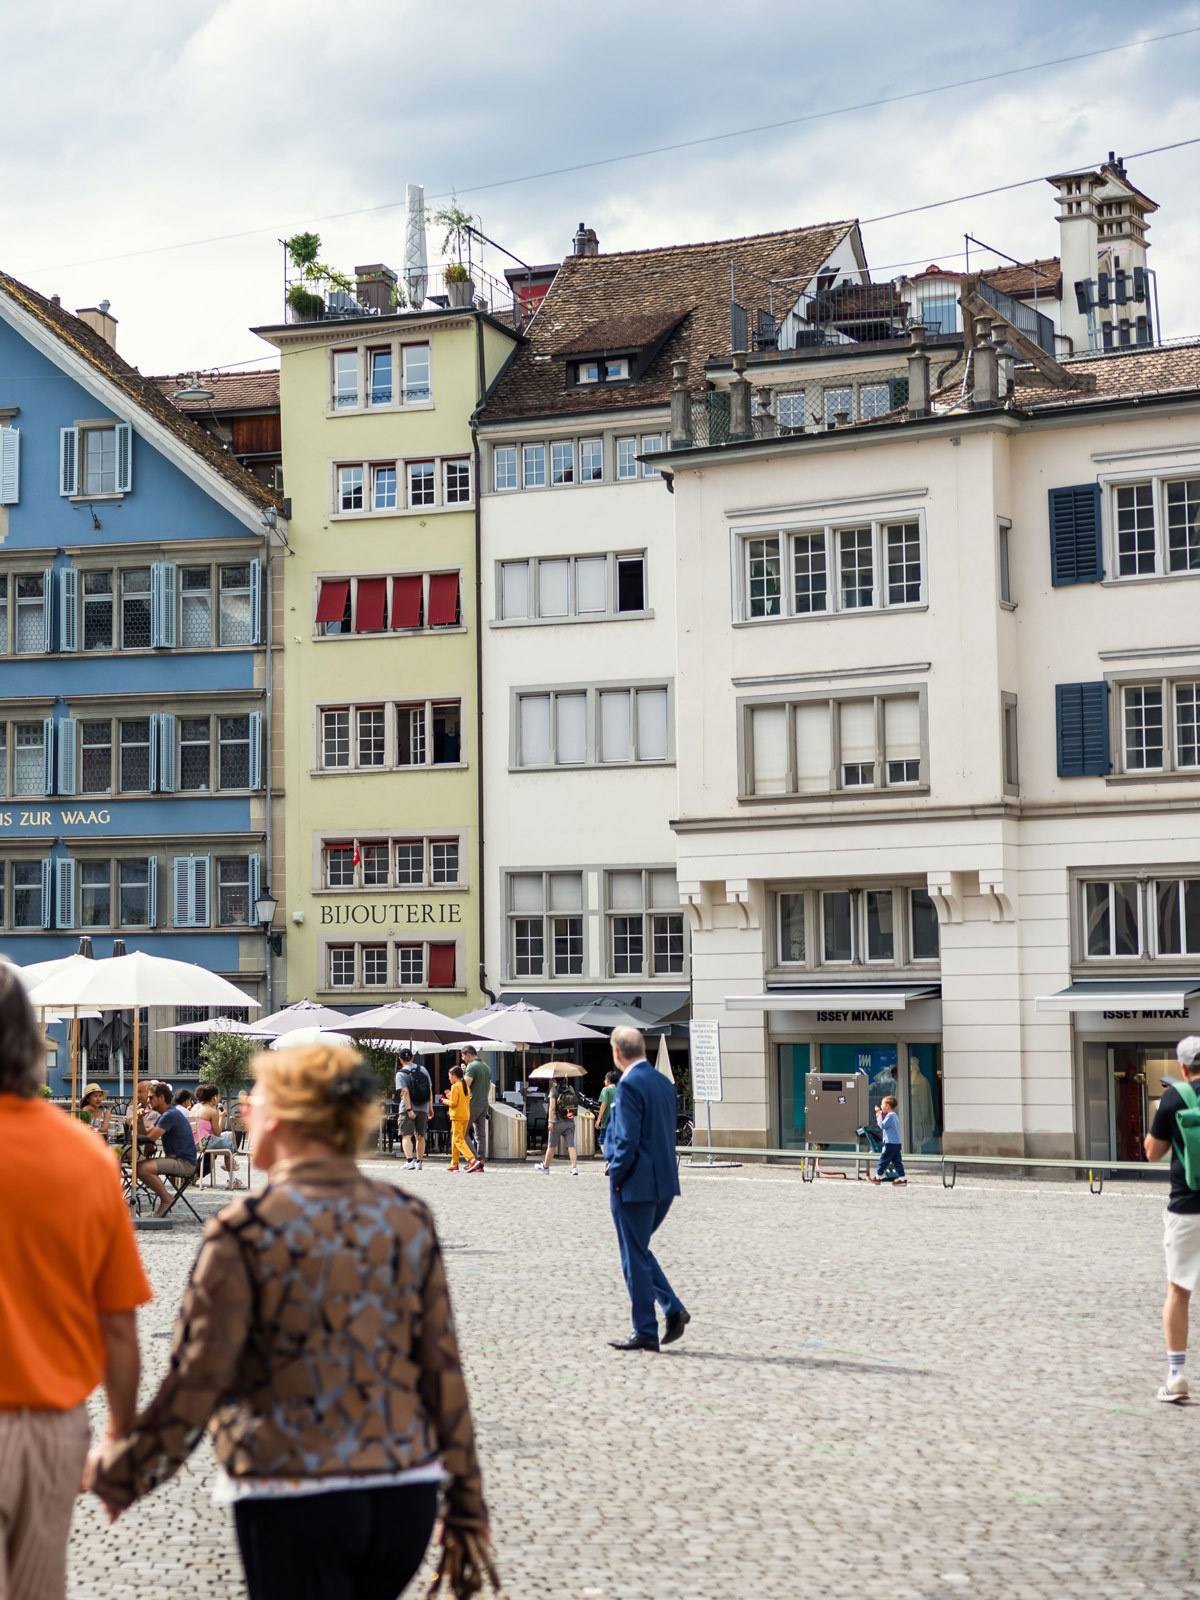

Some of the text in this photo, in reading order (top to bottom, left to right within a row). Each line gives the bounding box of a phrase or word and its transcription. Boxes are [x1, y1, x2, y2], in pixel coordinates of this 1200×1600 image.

[19, 811, 52, 826] ZUR
[60, 809, 111, 825] WAAG
[320, 903, 462, 925] BIJOUTERIE
[816, 1009, 894, 1022] ISSEY MIYAKE
[1103, 1007, 1189, 1019] ISSEY MIYAKE
